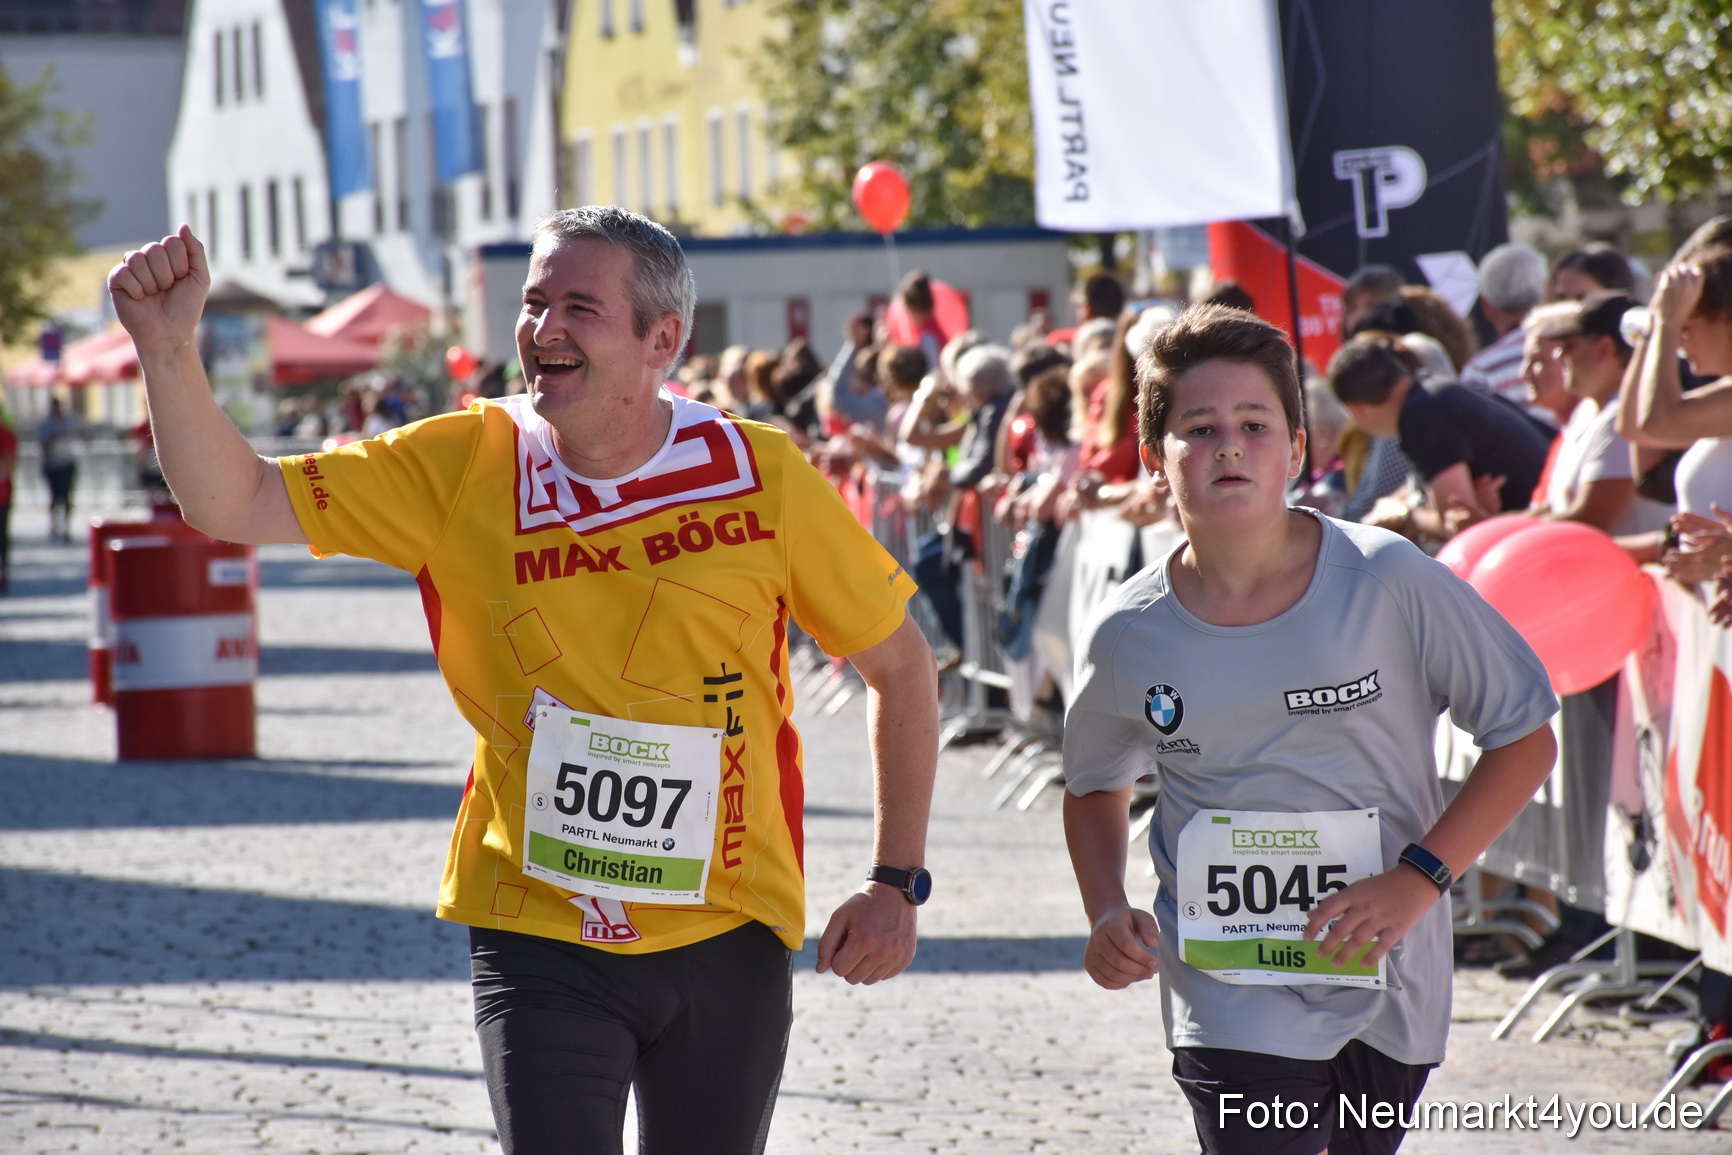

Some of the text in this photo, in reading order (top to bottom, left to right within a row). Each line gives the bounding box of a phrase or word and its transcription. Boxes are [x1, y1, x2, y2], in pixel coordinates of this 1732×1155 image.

[641, 510, 776, 566] BÖGL
[1284, 669, 1381, 710] BOCK
[1288, 707, 1320, 716] inspired
[1333, 703, 1356, 713] smart
[1356, 692, 1383, 707] concepts
[587, 750, 671, 769] inspired by smart concepts
[589, 732, 671, 762] BOCK
[554, 762, 692, 830] 5097
[561, 823, 658, 848] PARTL Neumarkt
[1232, 829, 1320, 848] BOCK
[1232, 848, 1260, 857] inspired
[1260, 849, 1269, 857] by
[1291, 849, 1322, 857] concepts
[563, 848, 663, 884] Christian
[1207, 864, 1349, 917] 5045
[1222, 922, 1324, 934] PARTL Neuma
[1257, 943, 1307, 968] Luis
